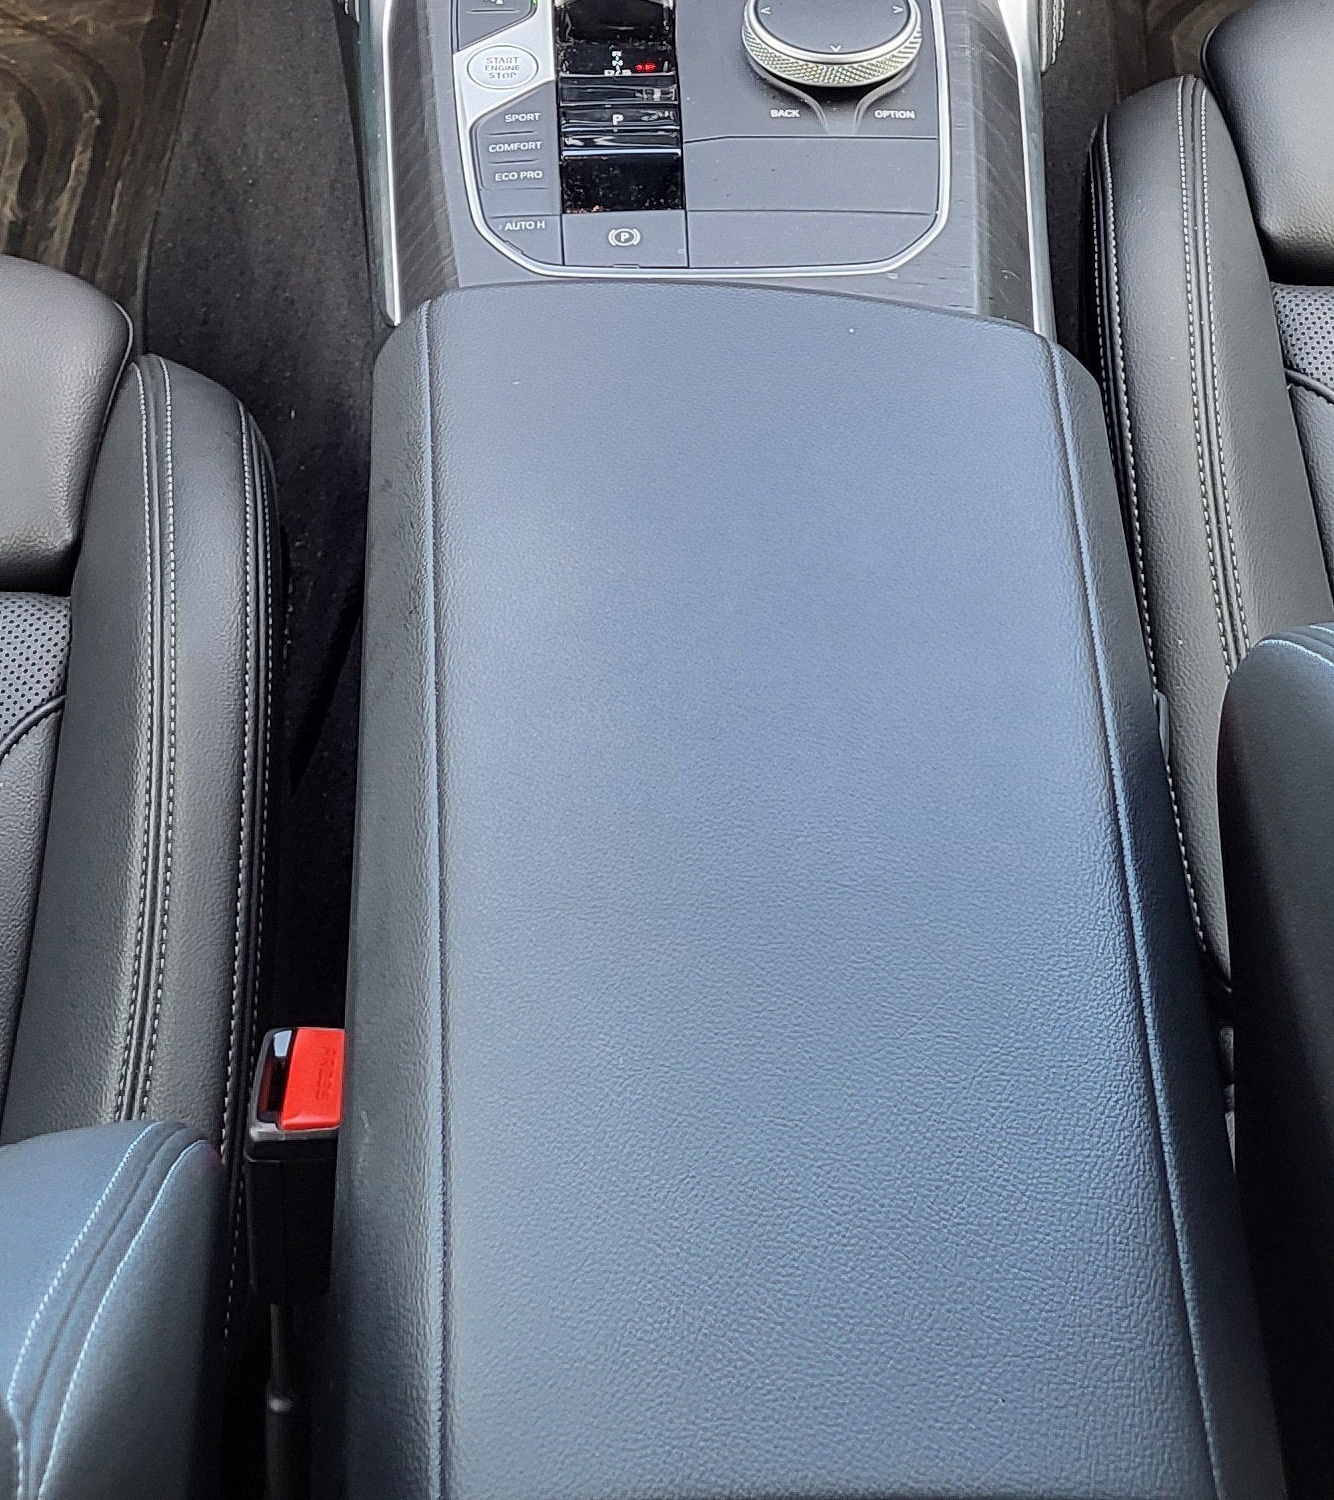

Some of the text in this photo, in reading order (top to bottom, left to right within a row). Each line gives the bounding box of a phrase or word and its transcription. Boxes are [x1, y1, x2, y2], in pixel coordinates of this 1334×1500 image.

[486, 56, 520, 65] START
[484, 64, 520, 72] ENGINE
[488, 72, 517, 80] STOP
[505, 112, 541, 123] SPORT
[770, 109, 801, 118] BACK
[874, 109, 916, 119] OPTION
[612, 113, 624, 126] P
[488, 141, 543, 153] COMFORT
[495, 170, 543, 182] ECO PRO
[505, 220, 545, 232] AUTO H
